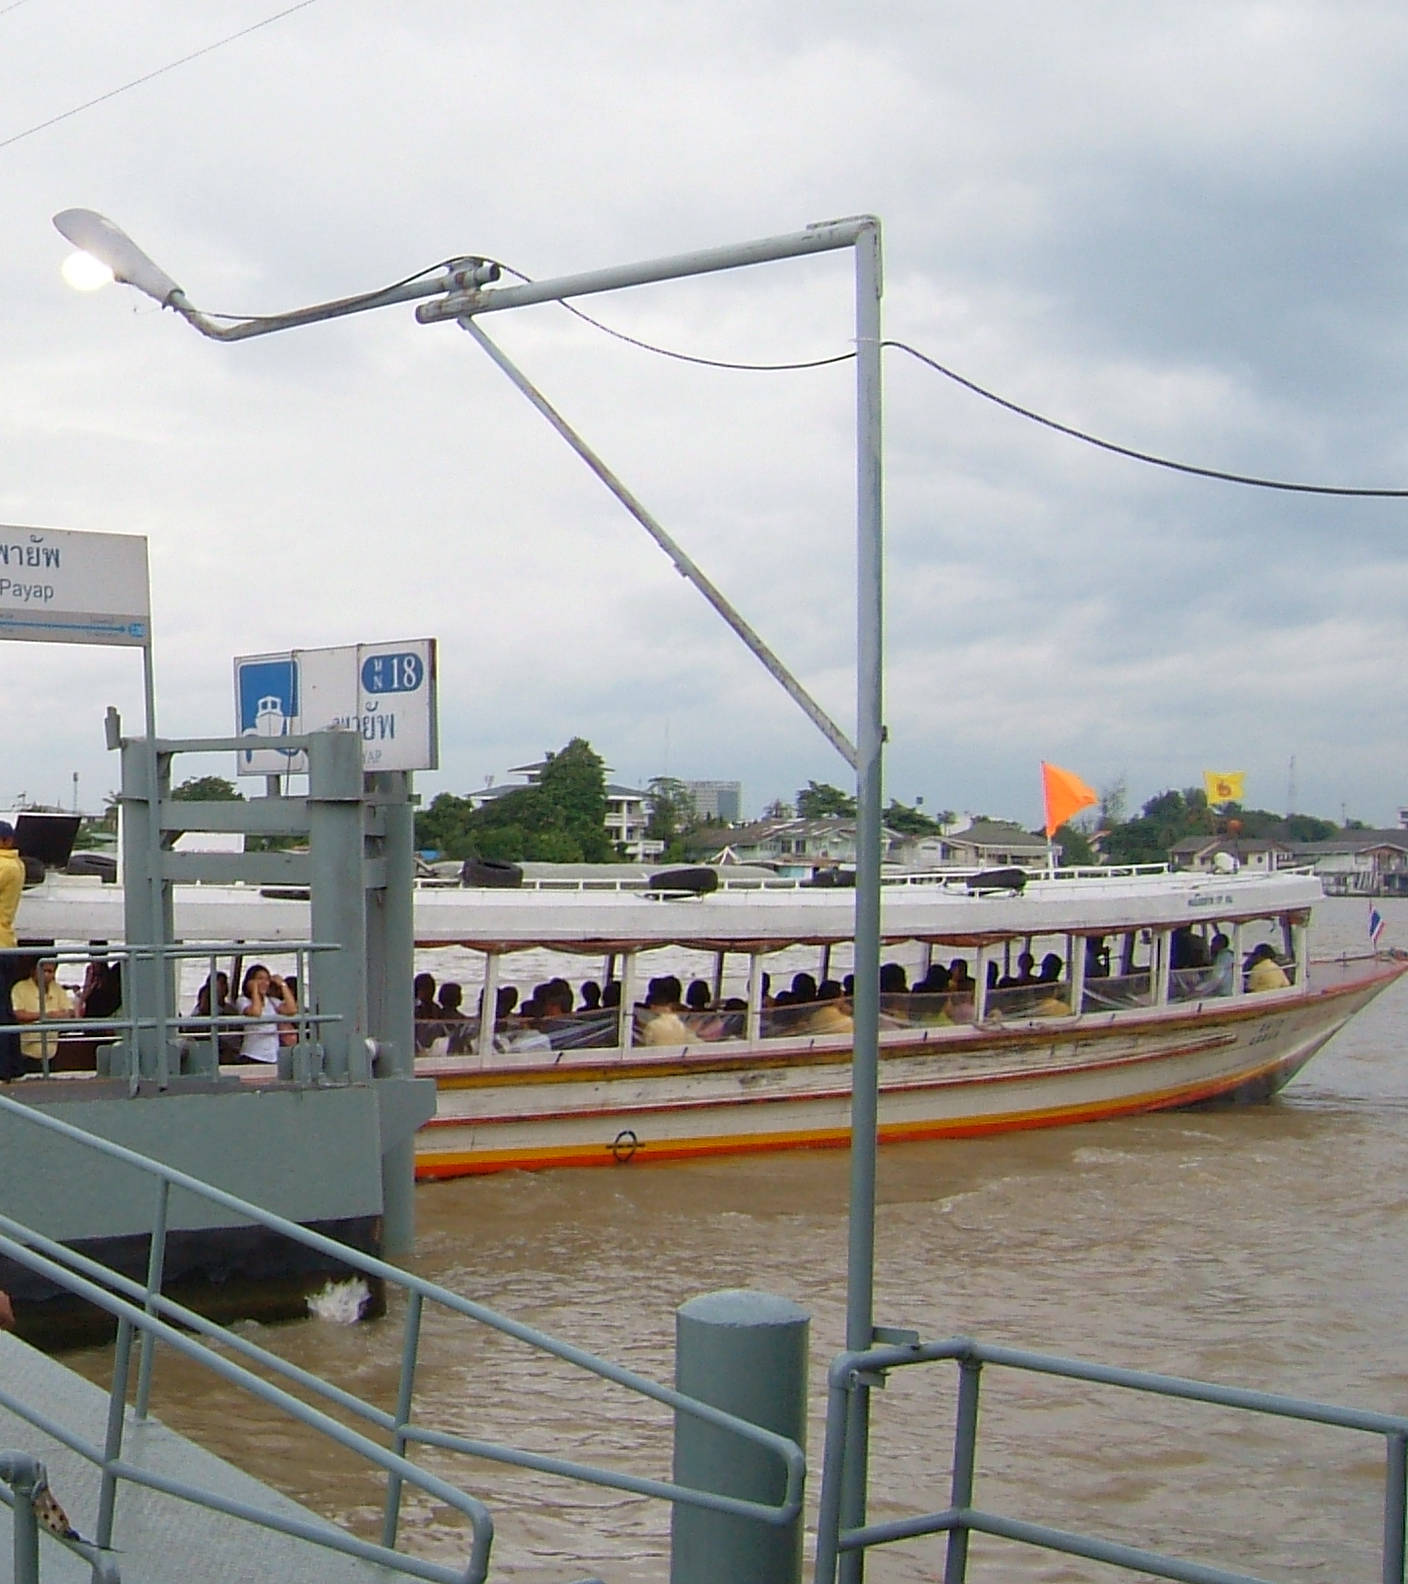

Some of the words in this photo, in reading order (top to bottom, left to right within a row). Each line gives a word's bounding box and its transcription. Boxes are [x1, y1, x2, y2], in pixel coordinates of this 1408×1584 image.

[0, 578, 54, 603] Payap
[373, 675, 383, 690] N
[391, 656, 417, 688] 18
